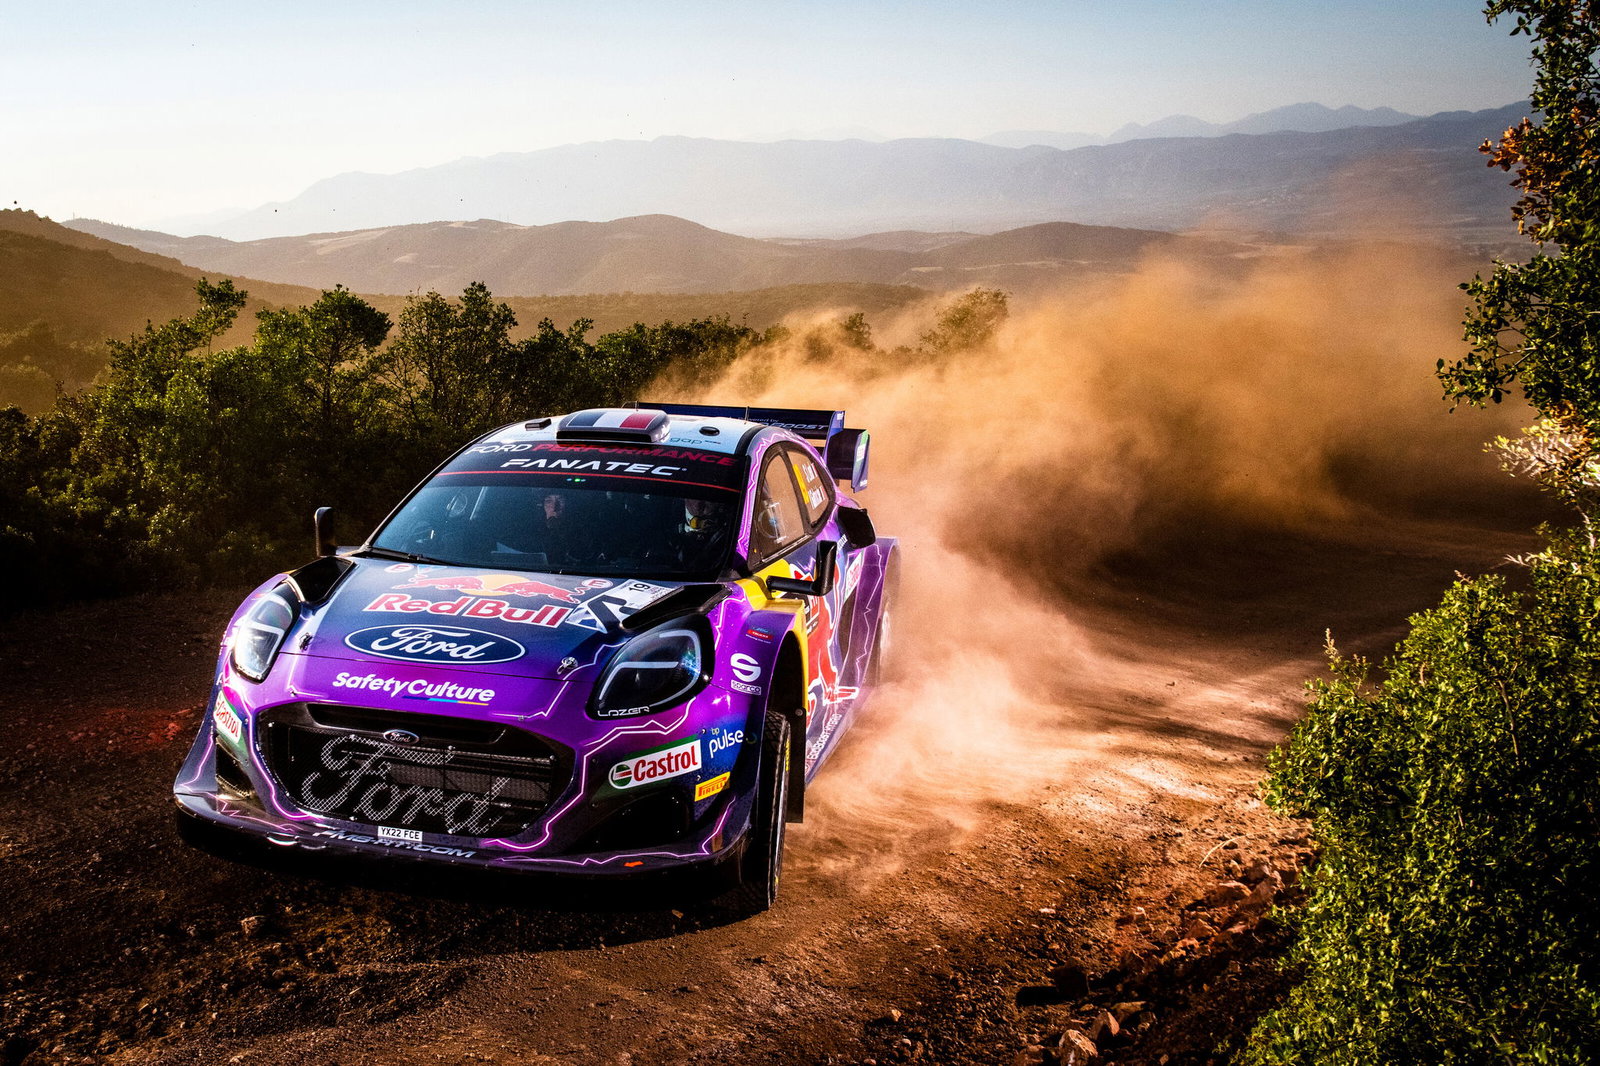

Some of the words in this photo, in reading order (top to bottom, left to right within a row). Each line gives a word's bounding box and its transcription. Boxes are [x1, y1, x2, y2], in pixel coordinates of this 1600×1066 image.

[464, 443, 533, 455] FORD
[531, 443, 738, 467] PERFORMANCE
[500, 458, 682, 476] FANATEC
[628, 583, 651, 593] 19
[370, 627, 496, 660] Ford
[332, 672, 496, 703] SafetyCulture
[732, 681, 761, 695] sparco
[390, 731, 411, 743] Ford
[709, 728, 744, 759] pulse
[633, 745, 699, 782] Castrol
[301, 735, 510, 835] Ford
[698, 776, 727, 797] PIRELL
[380, 827, 402, 838] YX22
[403, 829, 420, 840] FCE
